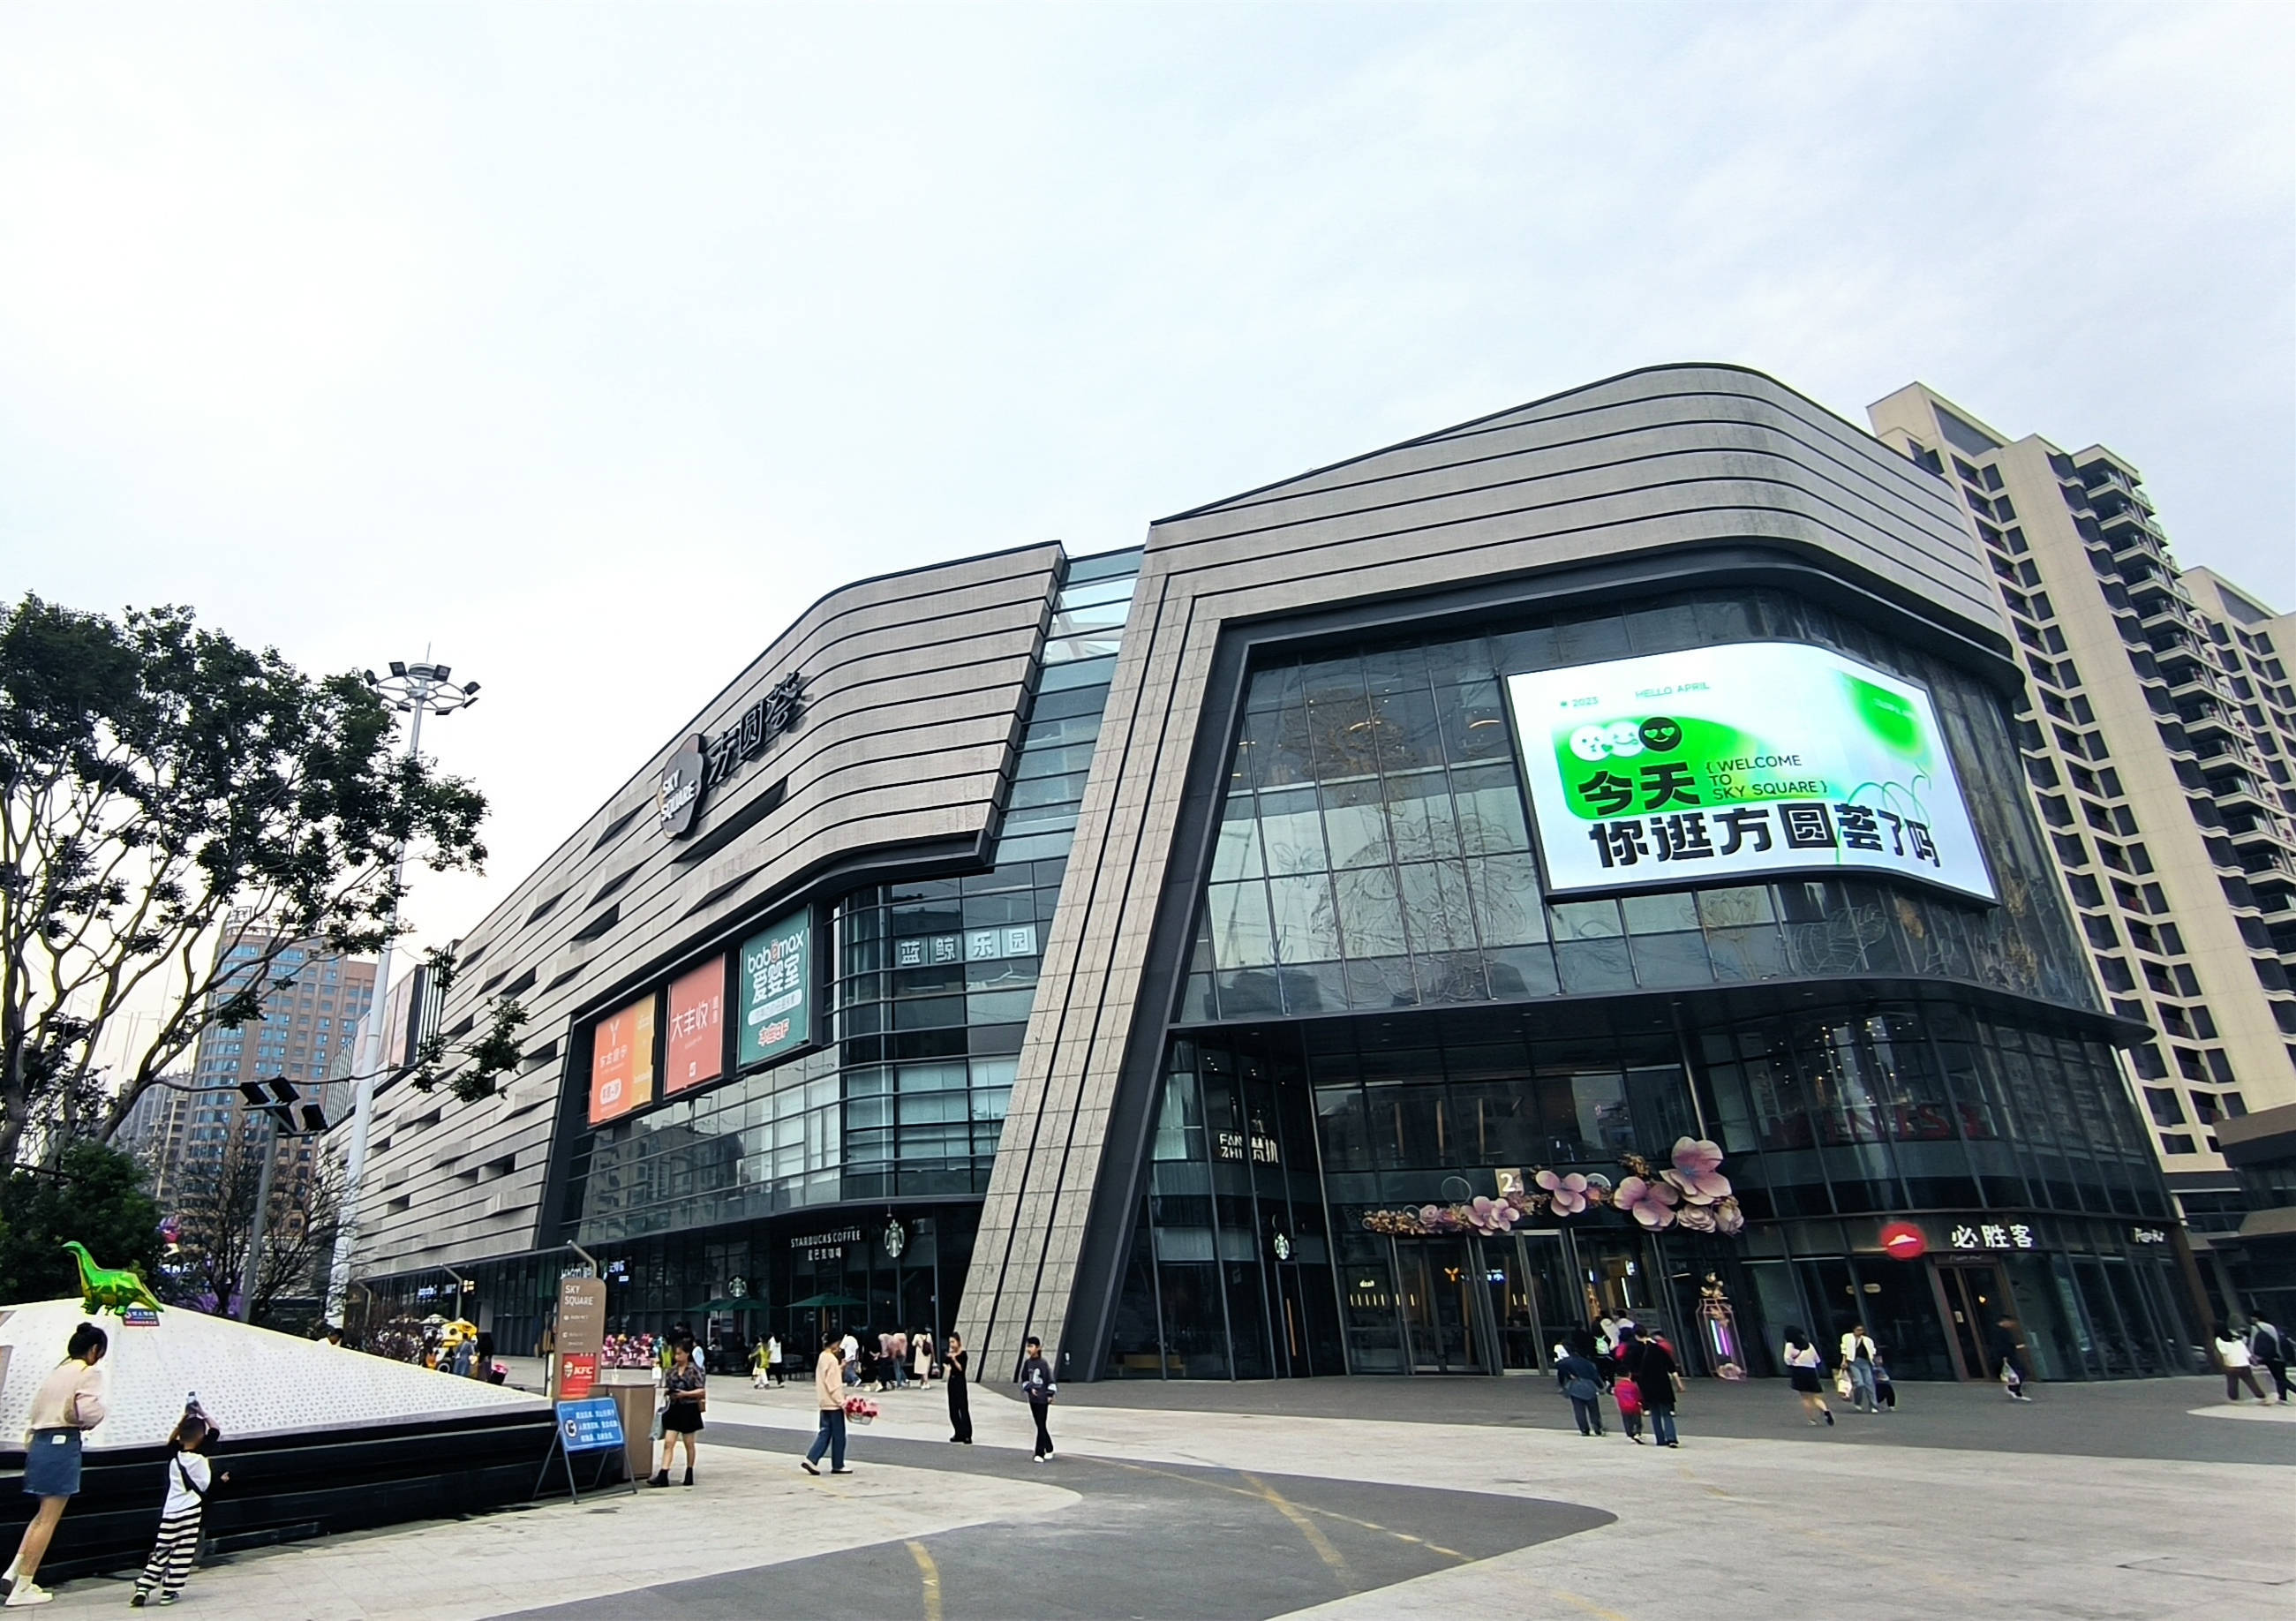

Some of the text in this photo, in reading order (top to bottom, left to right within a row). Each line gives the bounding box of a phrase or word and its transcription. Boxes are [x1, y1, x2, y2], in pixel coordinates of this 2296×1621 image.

[1636, 682, 1710, 697] HELLO APRIL
[1578, 761, 1700, 816] 今天
[1710, 774, 1732, 786] TO
[1713, 785, 1745, 800] SKY
[1589, 803, 1940, 868] 你逛方圆荟了吗
[901, 928, 1029, 964] 蓝鲸乐园
[672, 1000, 709, 1043] 大丰收
[1219, 1133, 1242, 1146] FAN
[1501, 1172, 1516, 1192] 2
[791, 1229, 861, 1248] STARBUCKS COFFEE
[1952, 1224, 2033, 1248] 必胜客
[565, 1285, 580, 1293] SKY
[564, 1296, 593, 1306] SQUARE
[574, 1366, 593, 1375] KFC
